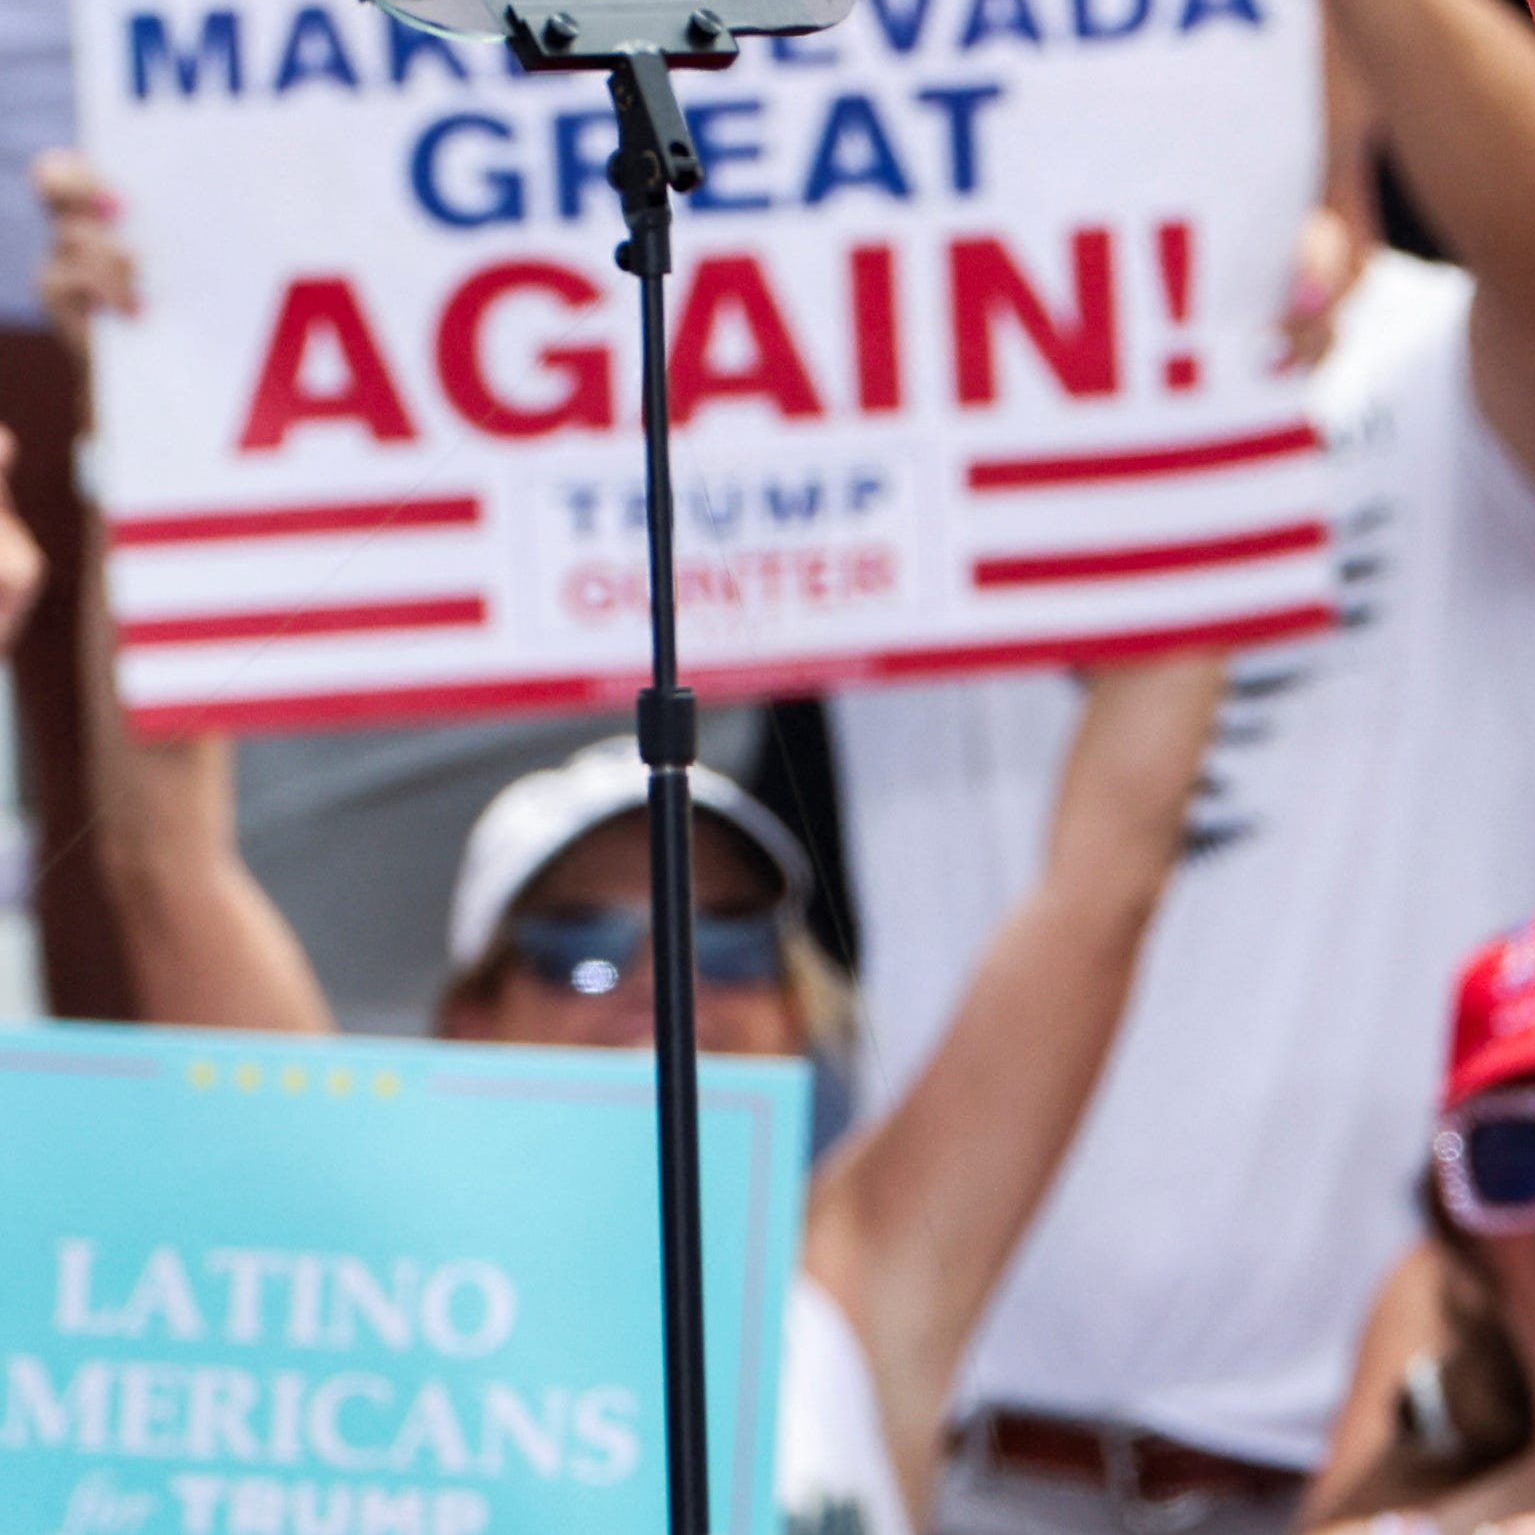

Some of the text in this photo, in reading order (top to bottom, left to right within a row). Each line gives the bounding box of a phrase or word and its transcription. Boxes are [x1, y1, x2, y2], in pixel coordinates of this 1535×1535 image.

[128, 6, 555, 101] MAK
[238, 221, 1200, 453] AGAIN!
[54, 1236, 518, 1360] LATINO
[0, 1352, 642, 1486] MERICANS
[168, 1472, 490, 1535] TRUMP
